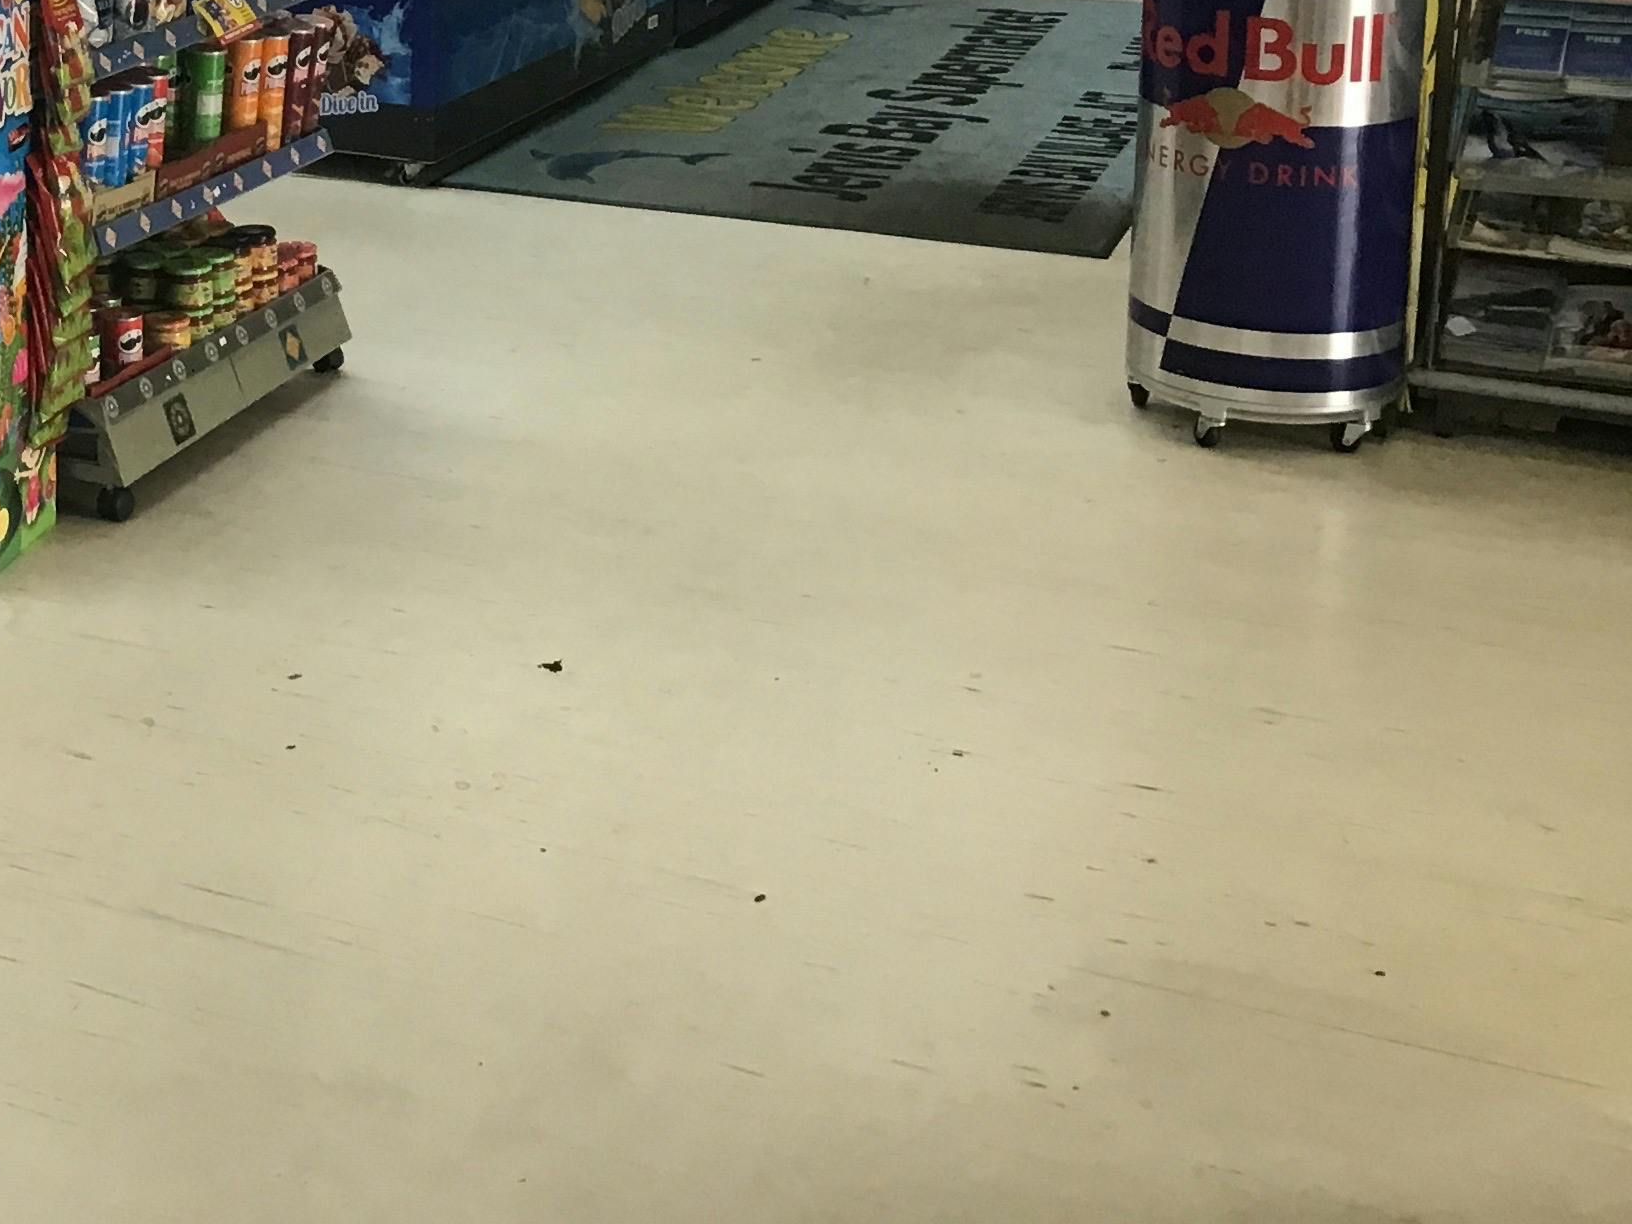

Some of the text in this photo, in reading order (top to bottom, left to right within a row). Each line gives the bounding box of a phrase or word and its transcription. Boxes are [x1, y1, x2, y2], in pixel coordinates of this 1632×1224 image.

[867, 7, 1068, 106] Supermarket
[1243, 13, 1385, 86] Bull
[319, 90, 379, 116] Dive in
[818, 103, 990, 143] Bay
[749, 143, 923, 202] Jervis
[1147, 146, 1358, 188] NERGY DRINK
